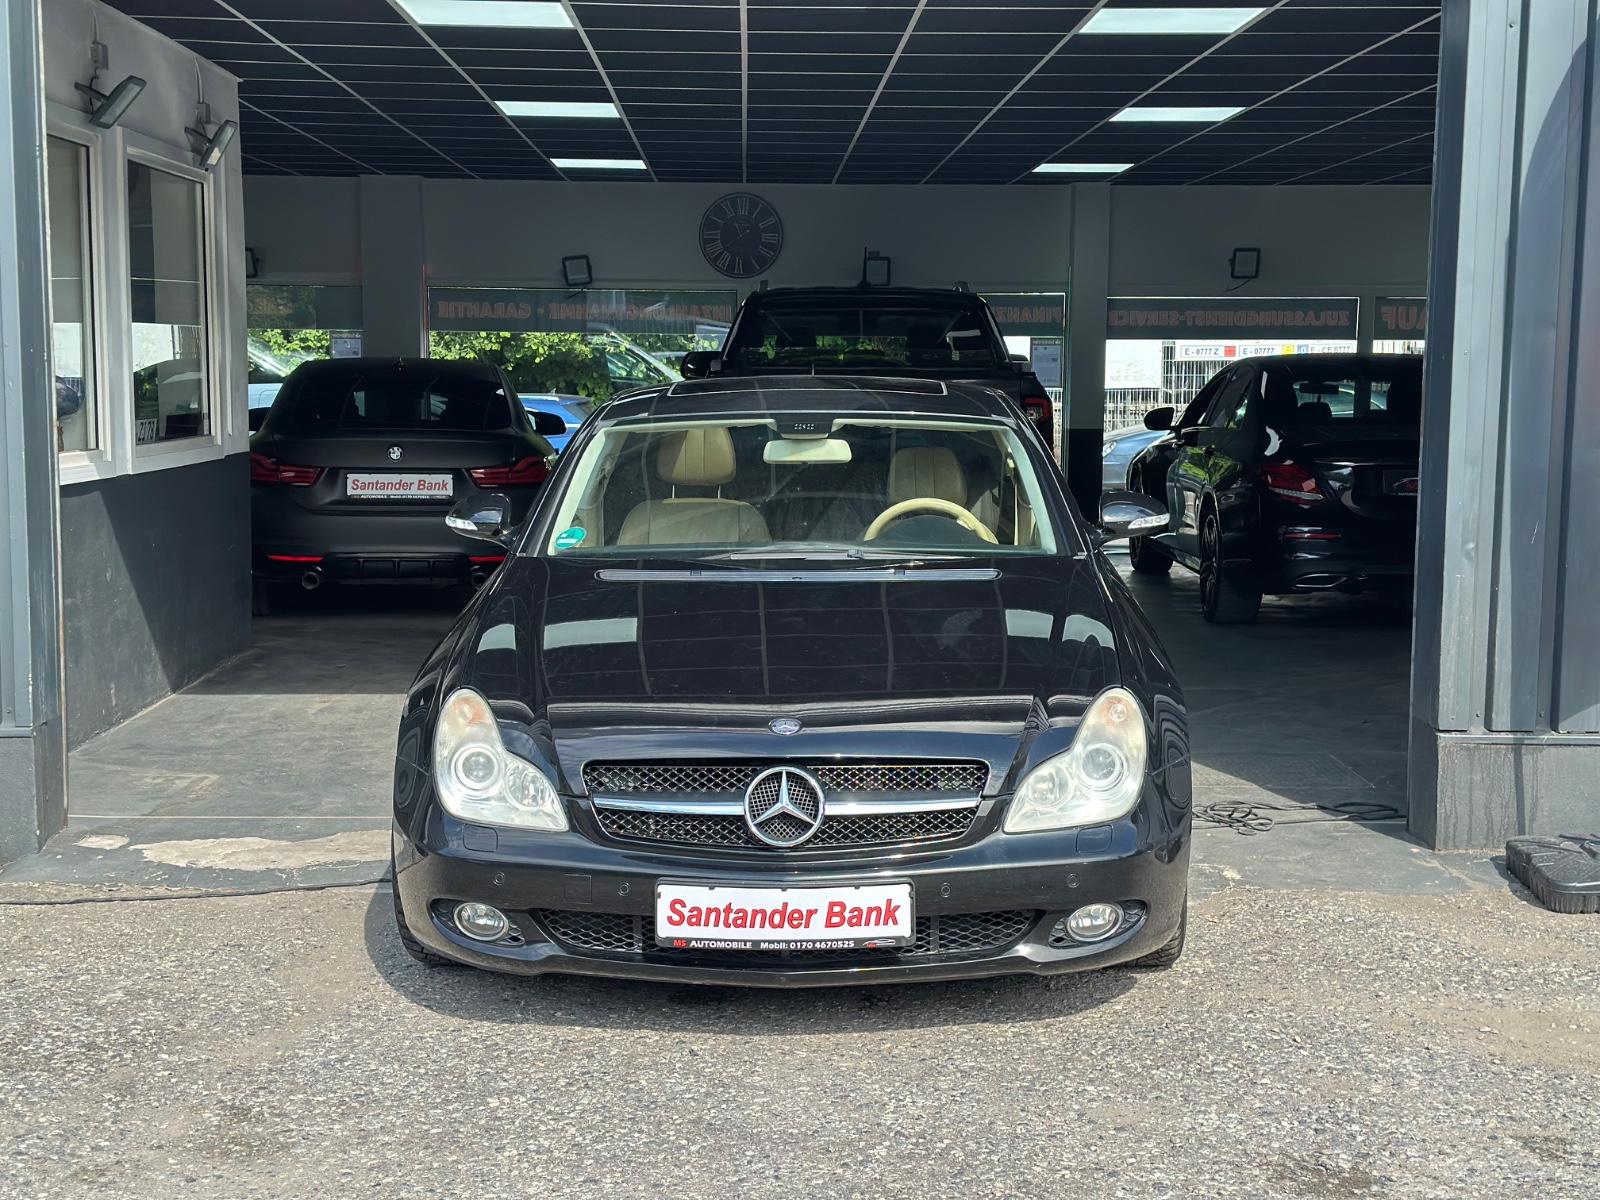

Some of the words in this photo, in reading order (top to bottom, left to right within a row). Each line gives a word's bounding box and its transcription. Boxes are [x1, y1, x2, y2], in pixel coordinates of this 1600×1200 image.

[351, 478, 415, 492] Santander
[417, 478, 449, 492] Bank
[667, 899, 818, 929] Santander
[825, 899, 900, 929] Bank
[673, 939, 688, 948] MS
[690, 940, 752, 949] AUTOMOBILE
[760, 941, 788, 949] Mobil:
[815, 940, 855, 949] 4670525
